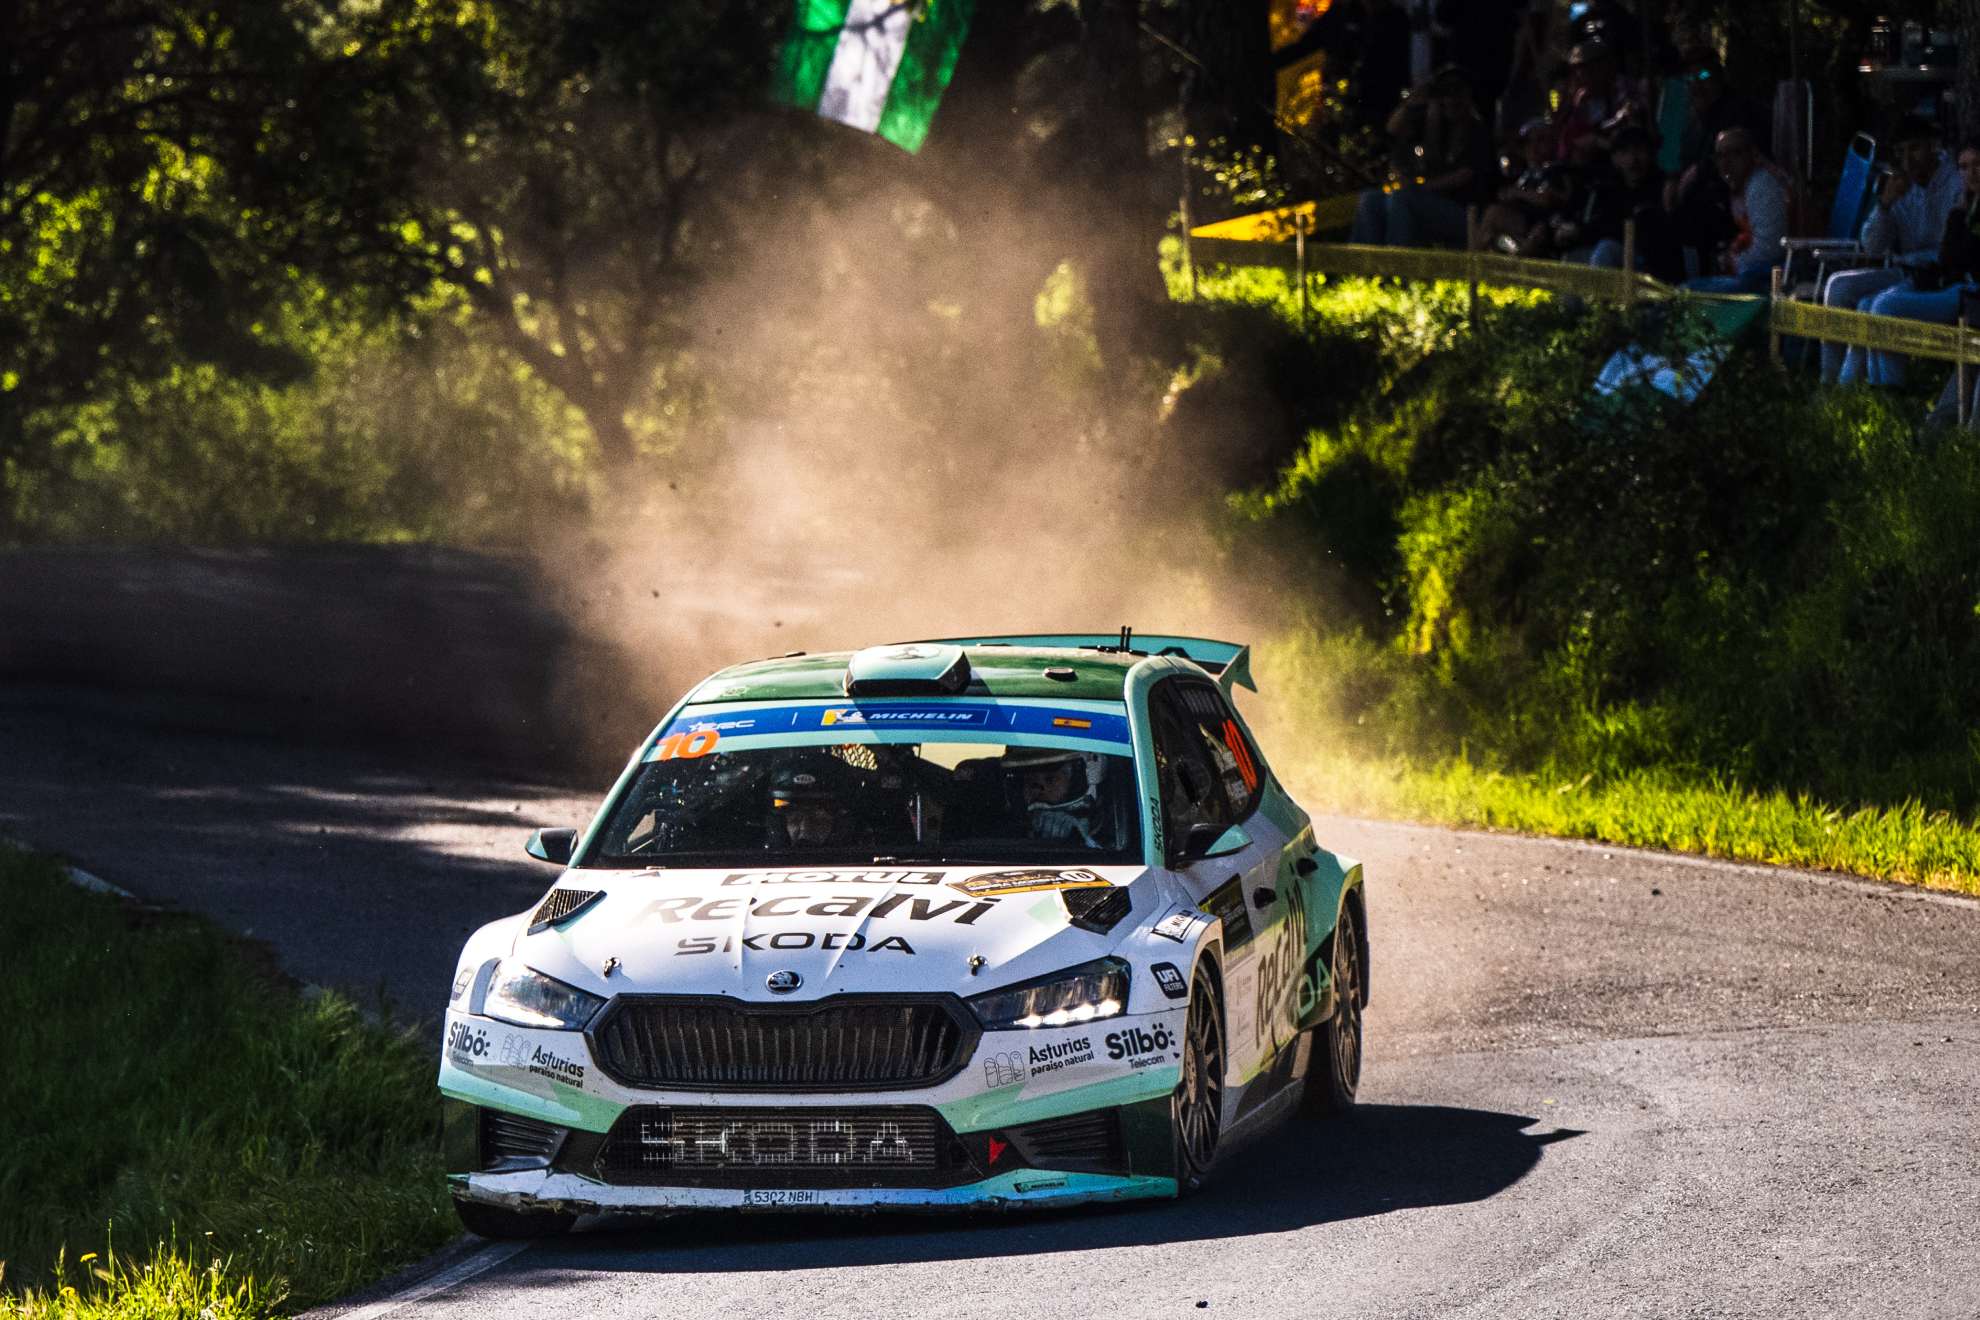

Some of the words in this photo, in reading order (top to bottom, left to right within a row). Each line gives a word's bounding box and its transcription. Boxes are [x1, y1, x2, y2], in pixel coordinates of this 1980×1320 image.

[869, 712, 974, 720] MICHELIN
[656, 729, 720, 762] 10
[736, 871, 935, 885] MOTUL
[1155, 968, 1180, 984] UFI
[1029, 1037, 1091, 1064] Asturias
[1064, 1050, 1094, 1067] natural
[531, 1045, 584, 1077] Asturias
[1128, 1055, 1166, 1069] Telecom
[556, 1073, 583, 1089] natural
[789, 1191, 812, 1202] NBH
